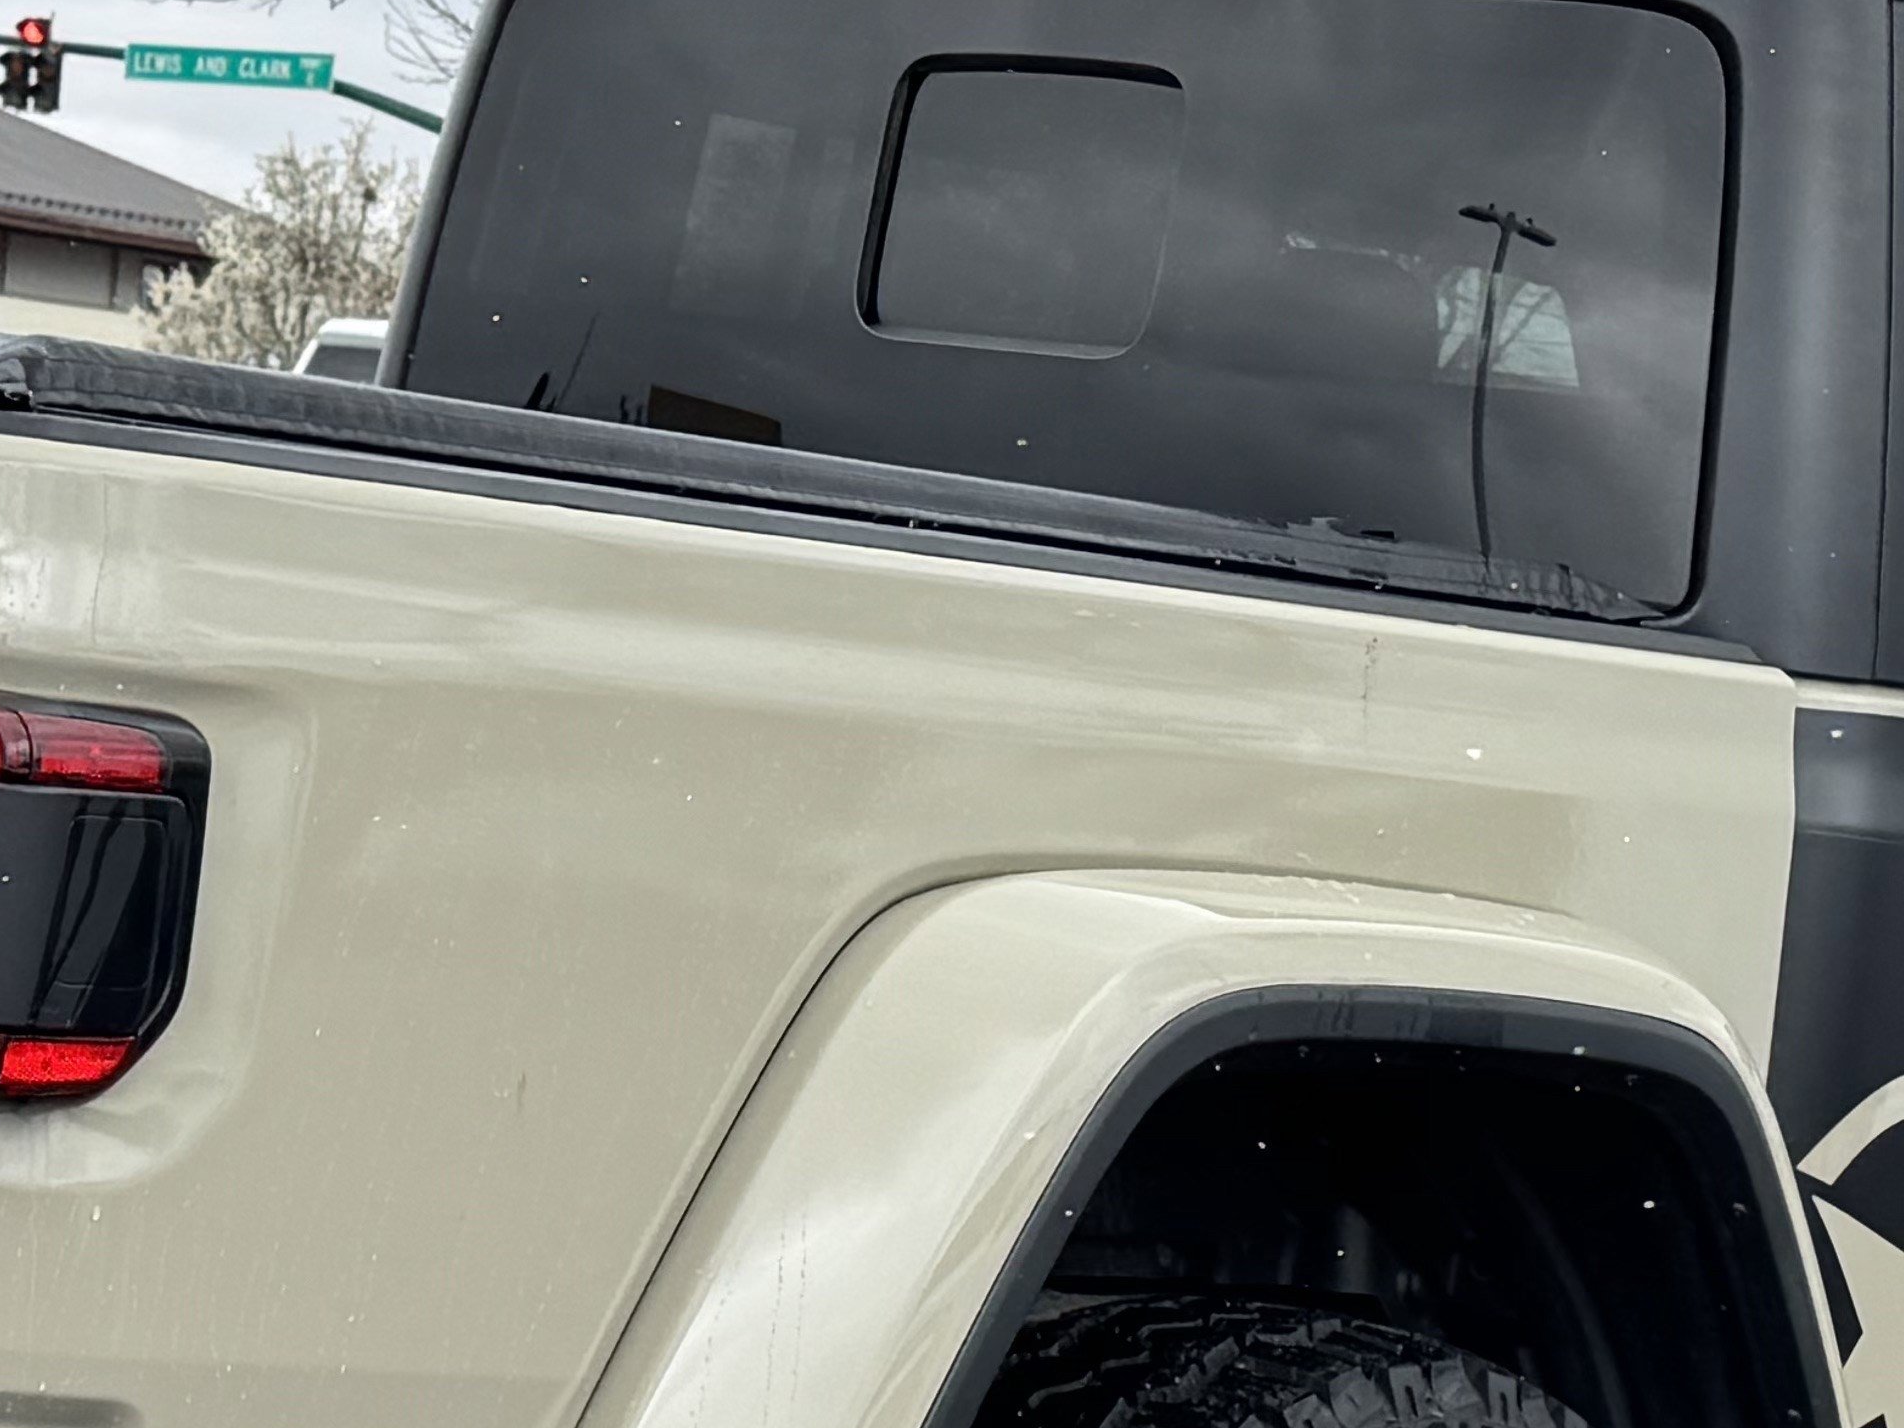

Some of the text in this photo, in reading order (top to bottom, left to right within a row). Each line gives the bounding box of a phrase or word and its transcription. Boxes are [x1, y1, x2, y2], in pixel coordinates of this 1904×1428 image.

[133, 51, 182, 74] LEWIS
[195, 55, 228, 78] AND
[238, 56, 292, 80] CLARK
